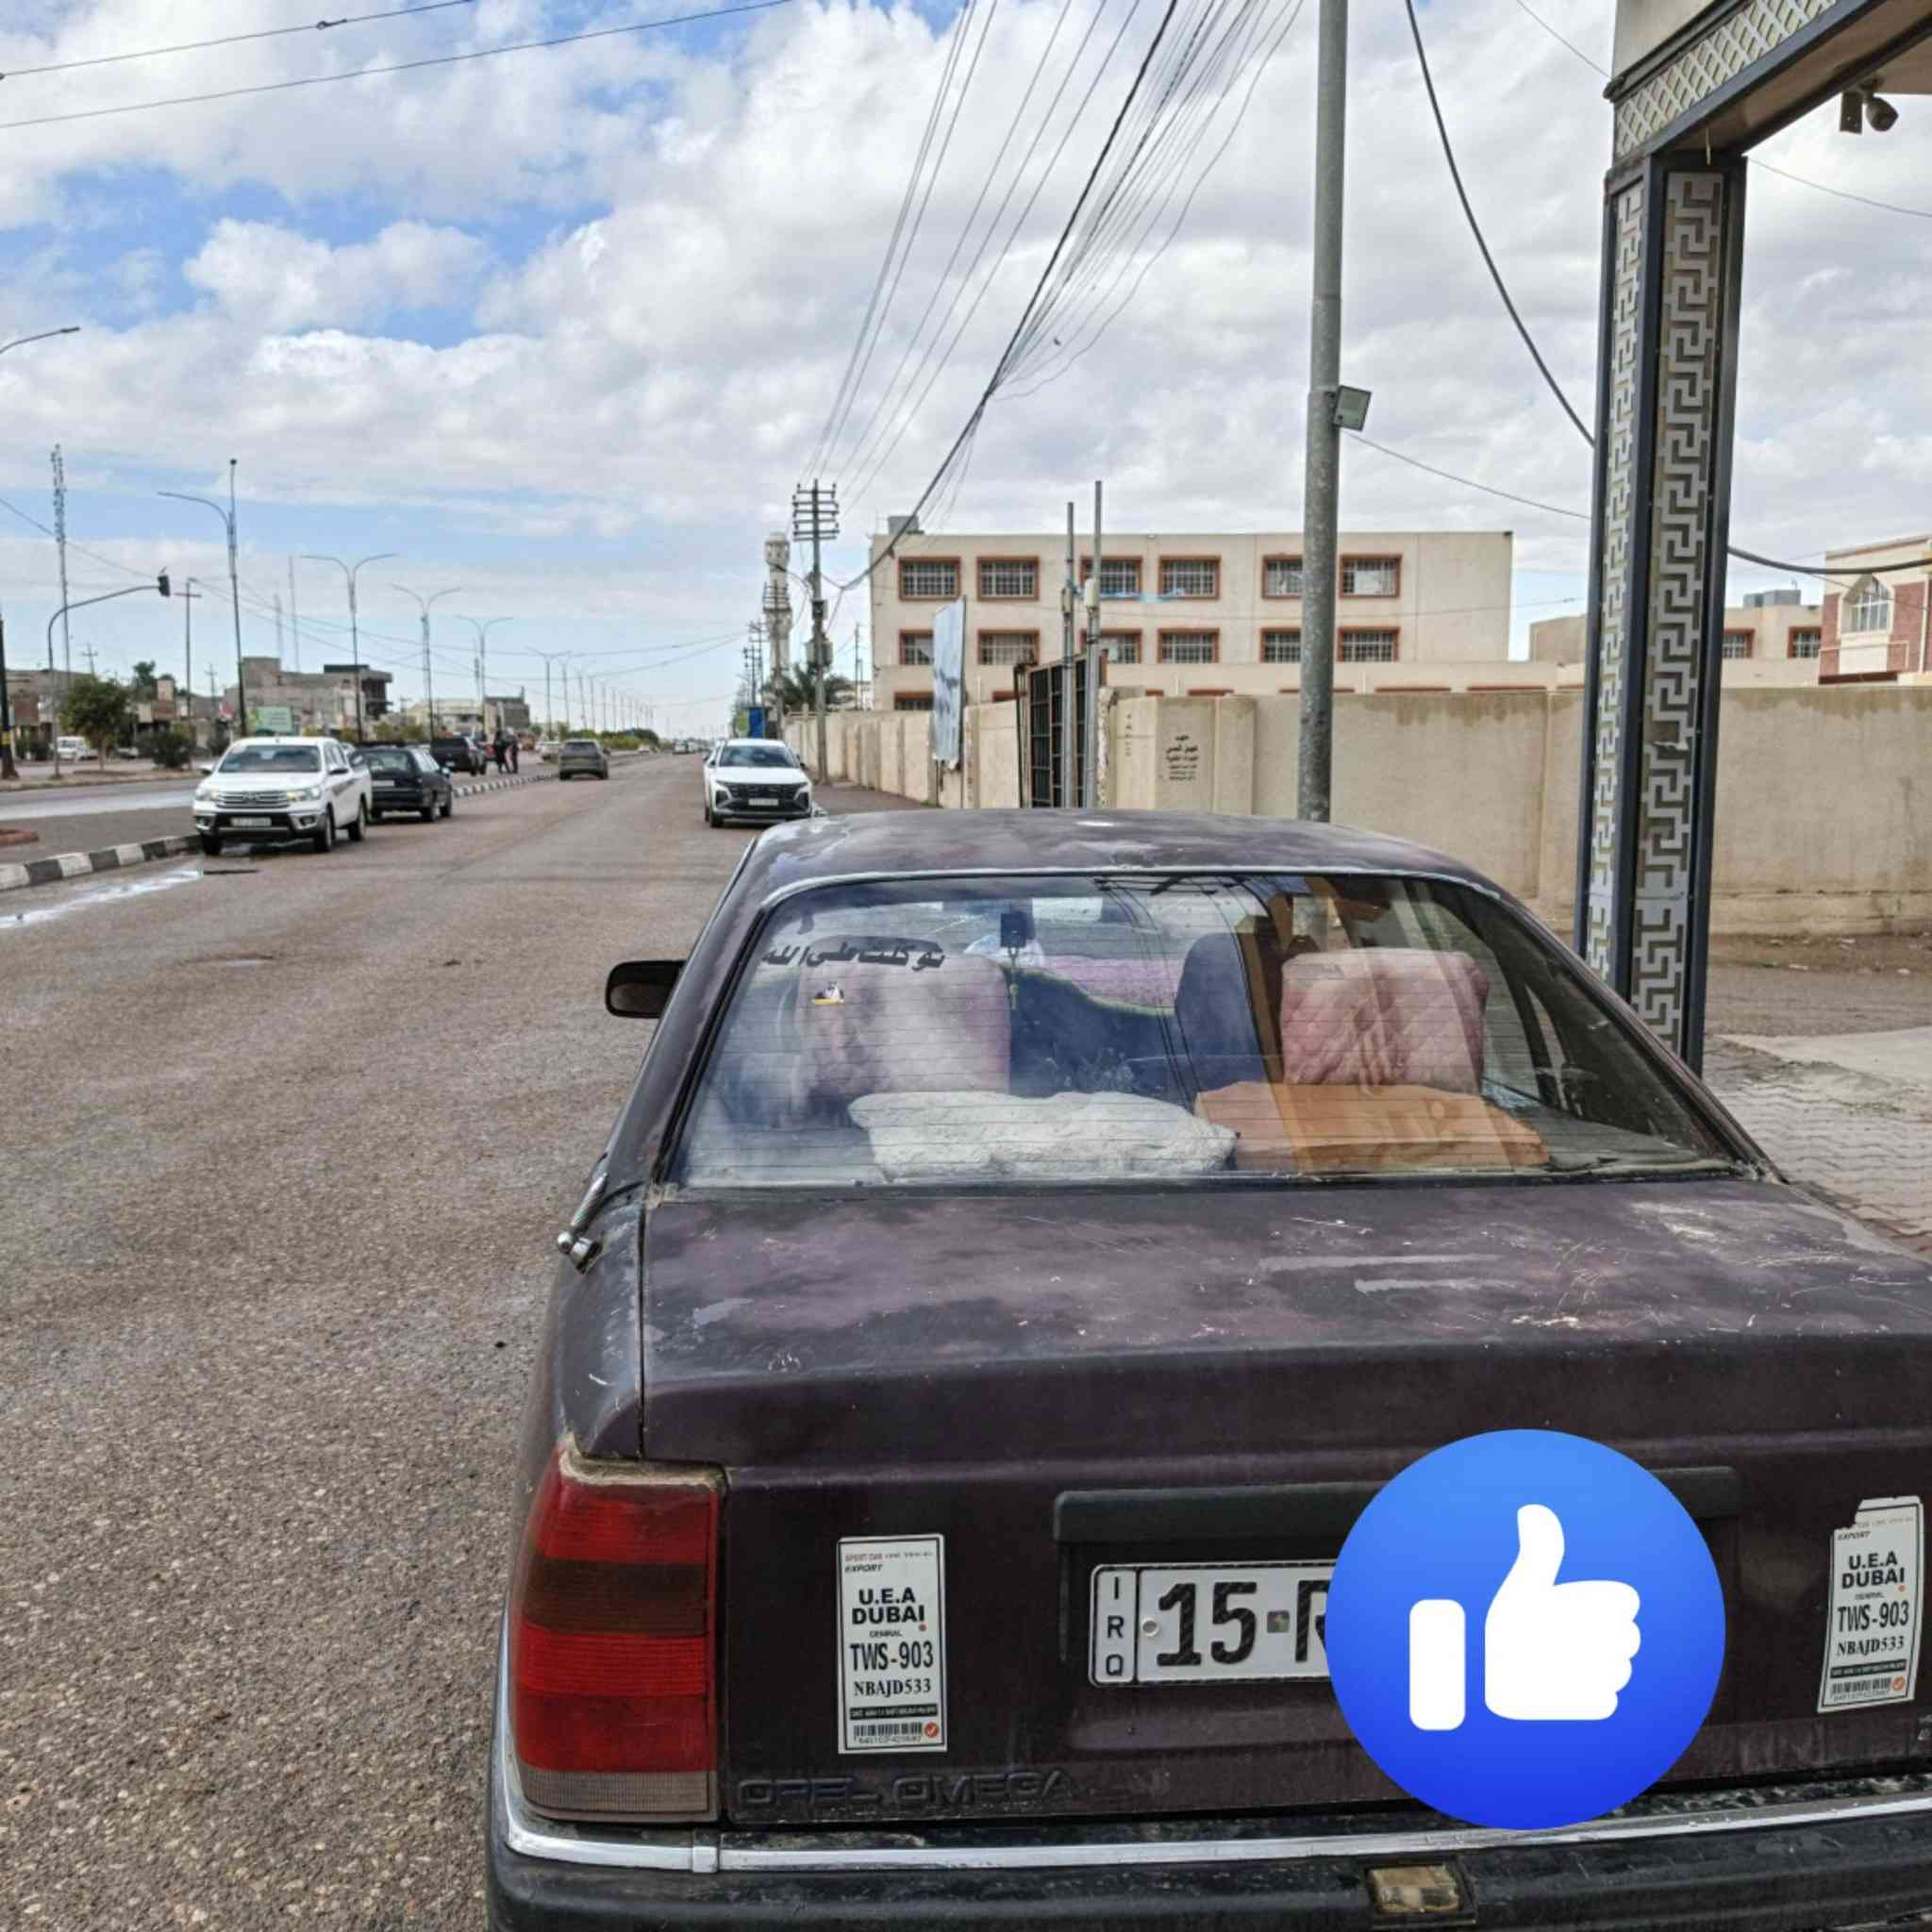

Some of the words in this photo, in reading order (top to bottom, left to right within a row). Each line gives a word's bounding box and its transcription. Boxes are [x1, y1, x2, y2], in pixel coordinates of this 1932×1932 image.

[1848, 1551, 1898, 1571] U.E.A
[1841, 1567, 1906, 1590] DUBAI
[858, 1587, 916, 1606] U.E.A
[851, 1605, 925, 1624] DUBAI
[1157, 1582, 1257, 1667] 15
[1838, 1600, 1910, 1633] TWS-903
[850, 1641, 934, 1672] TWS-903
[1837, 1636, 1906, 1657] NBAJD533
[853, 1678, 932, 1699] NBAJD533
